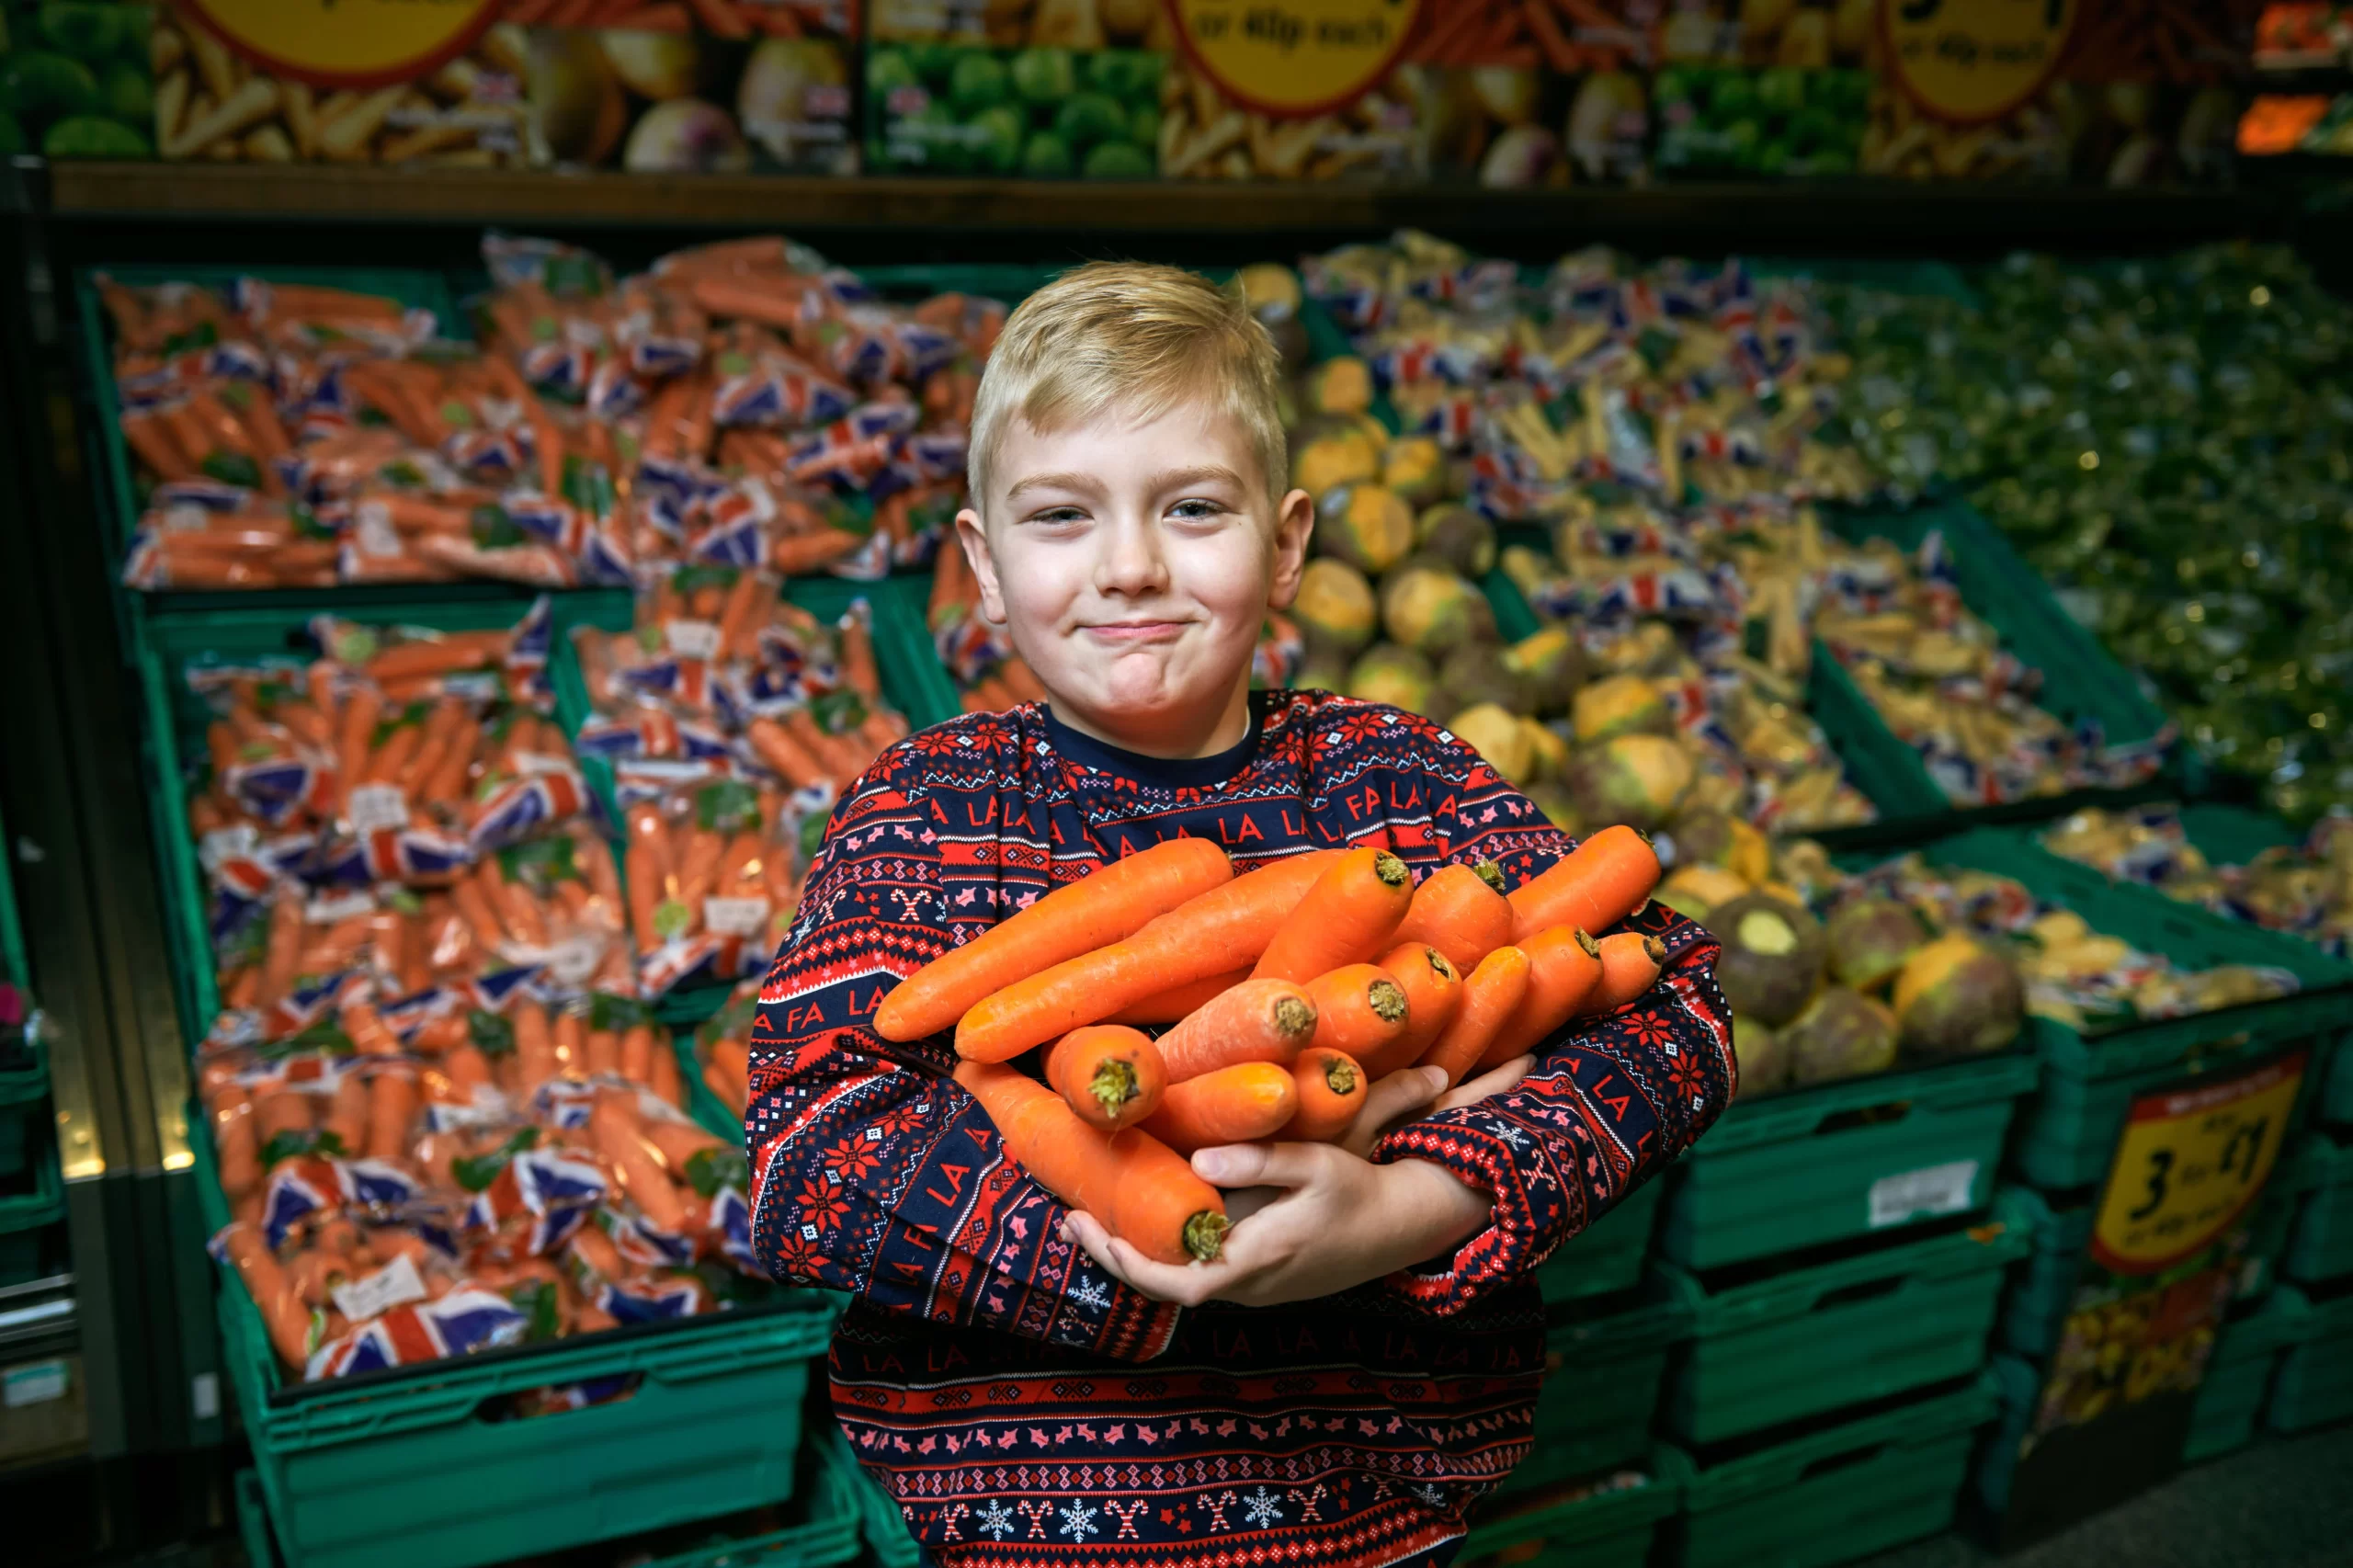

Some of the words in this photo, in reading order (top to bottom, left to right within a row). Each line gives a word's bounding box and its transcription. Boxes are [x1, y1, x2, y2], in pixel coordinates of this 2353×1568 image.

[1003, 801, 1038, 835] LA
[1217, 812, 1266, 845] LA
[1345, 784, 1382, 822] FA
[1390, 780, 1423, 810] LA
[786, 1000, 825, 1034] FA
[848, 984, 887, 1017] LA
[1592, 1073, 1631, 1123] LA
[926, 1162, 972, 1208] LA
[2130, 1148, 2174, 1221] 3
[860, 1352, 906, 1375] LA
[926, 1342, 971, 1374] LA
[1211, 1327, 1256, 1361] LA
[1274, 1324, 1321, 1356] LA
[1382, 1330, 1420, 1361] LA
